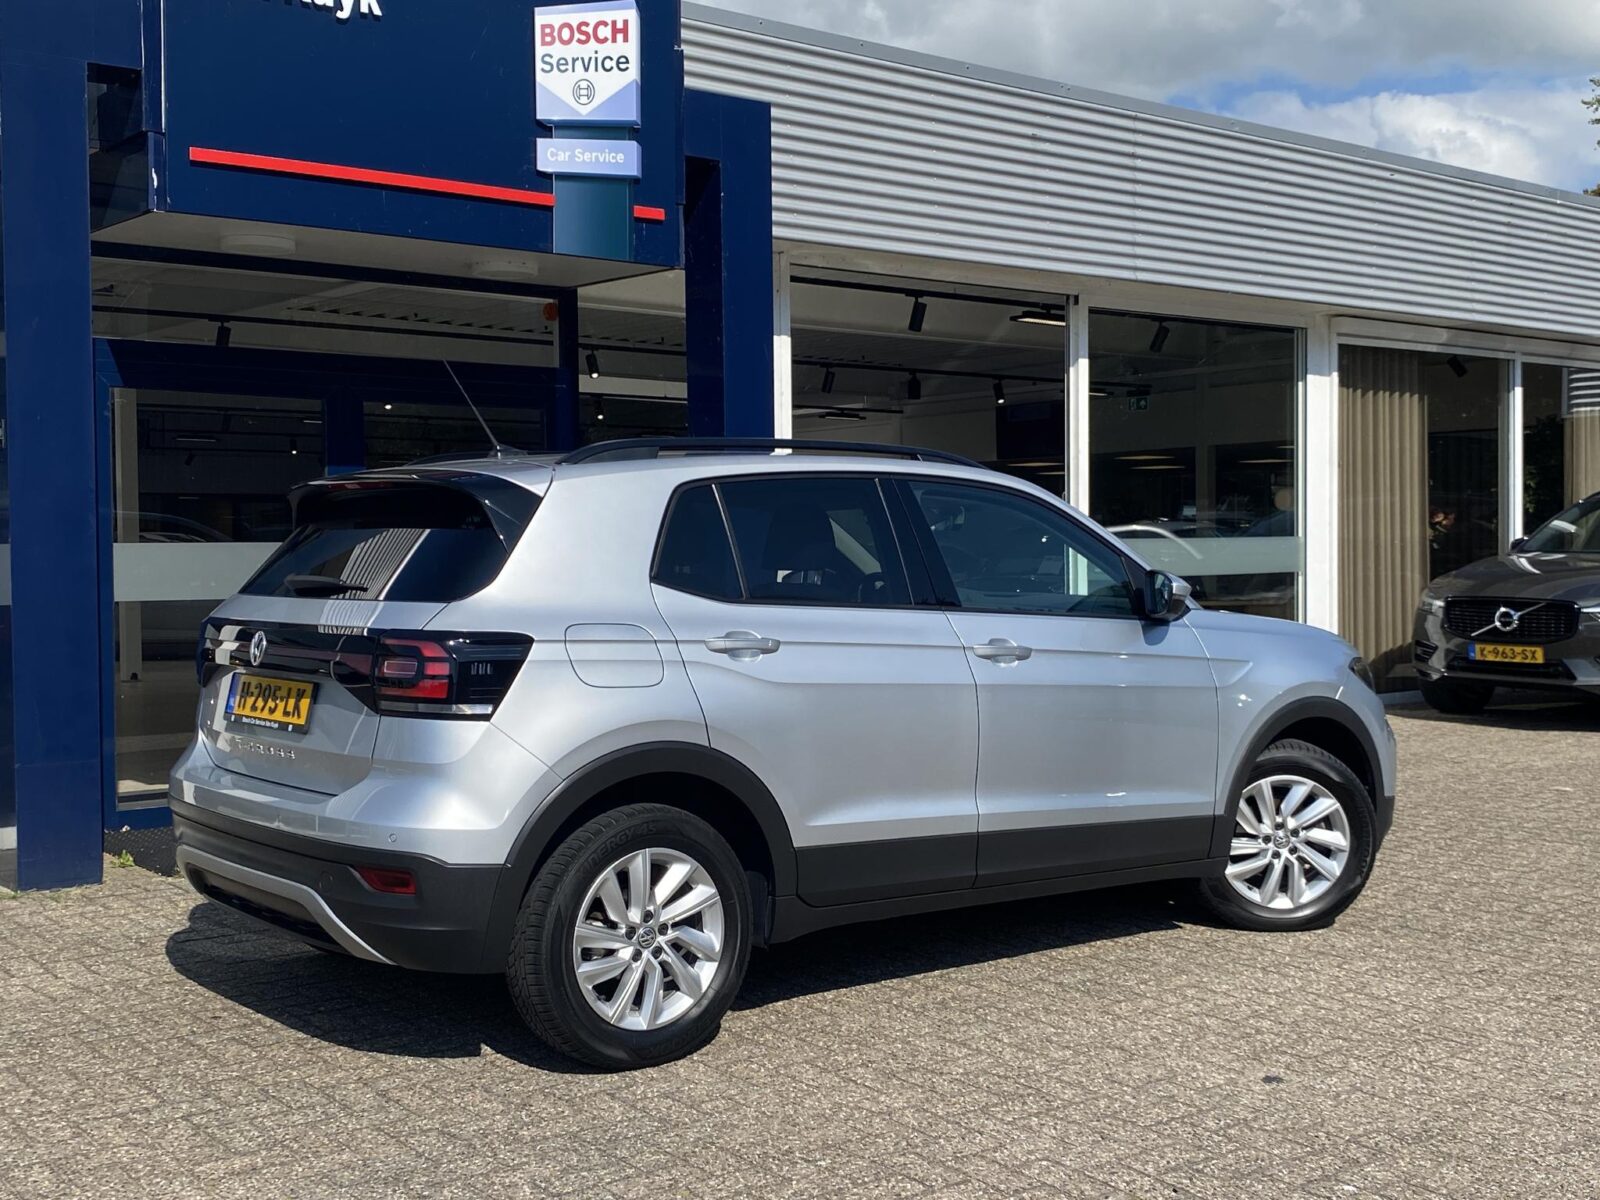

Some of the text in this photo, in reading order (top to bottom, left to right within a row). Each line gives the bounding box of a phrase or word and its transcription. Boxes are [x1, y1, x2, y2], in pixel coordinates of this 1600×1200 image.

[540, 19, 629, 47] BOSCH
[540, 50, 630, 74] Service
[547, 148, 625, 163] Car Service
[1479, 646, 1538, 661] K-963-SX
[237, 681, 306, 719] H-295-LK
